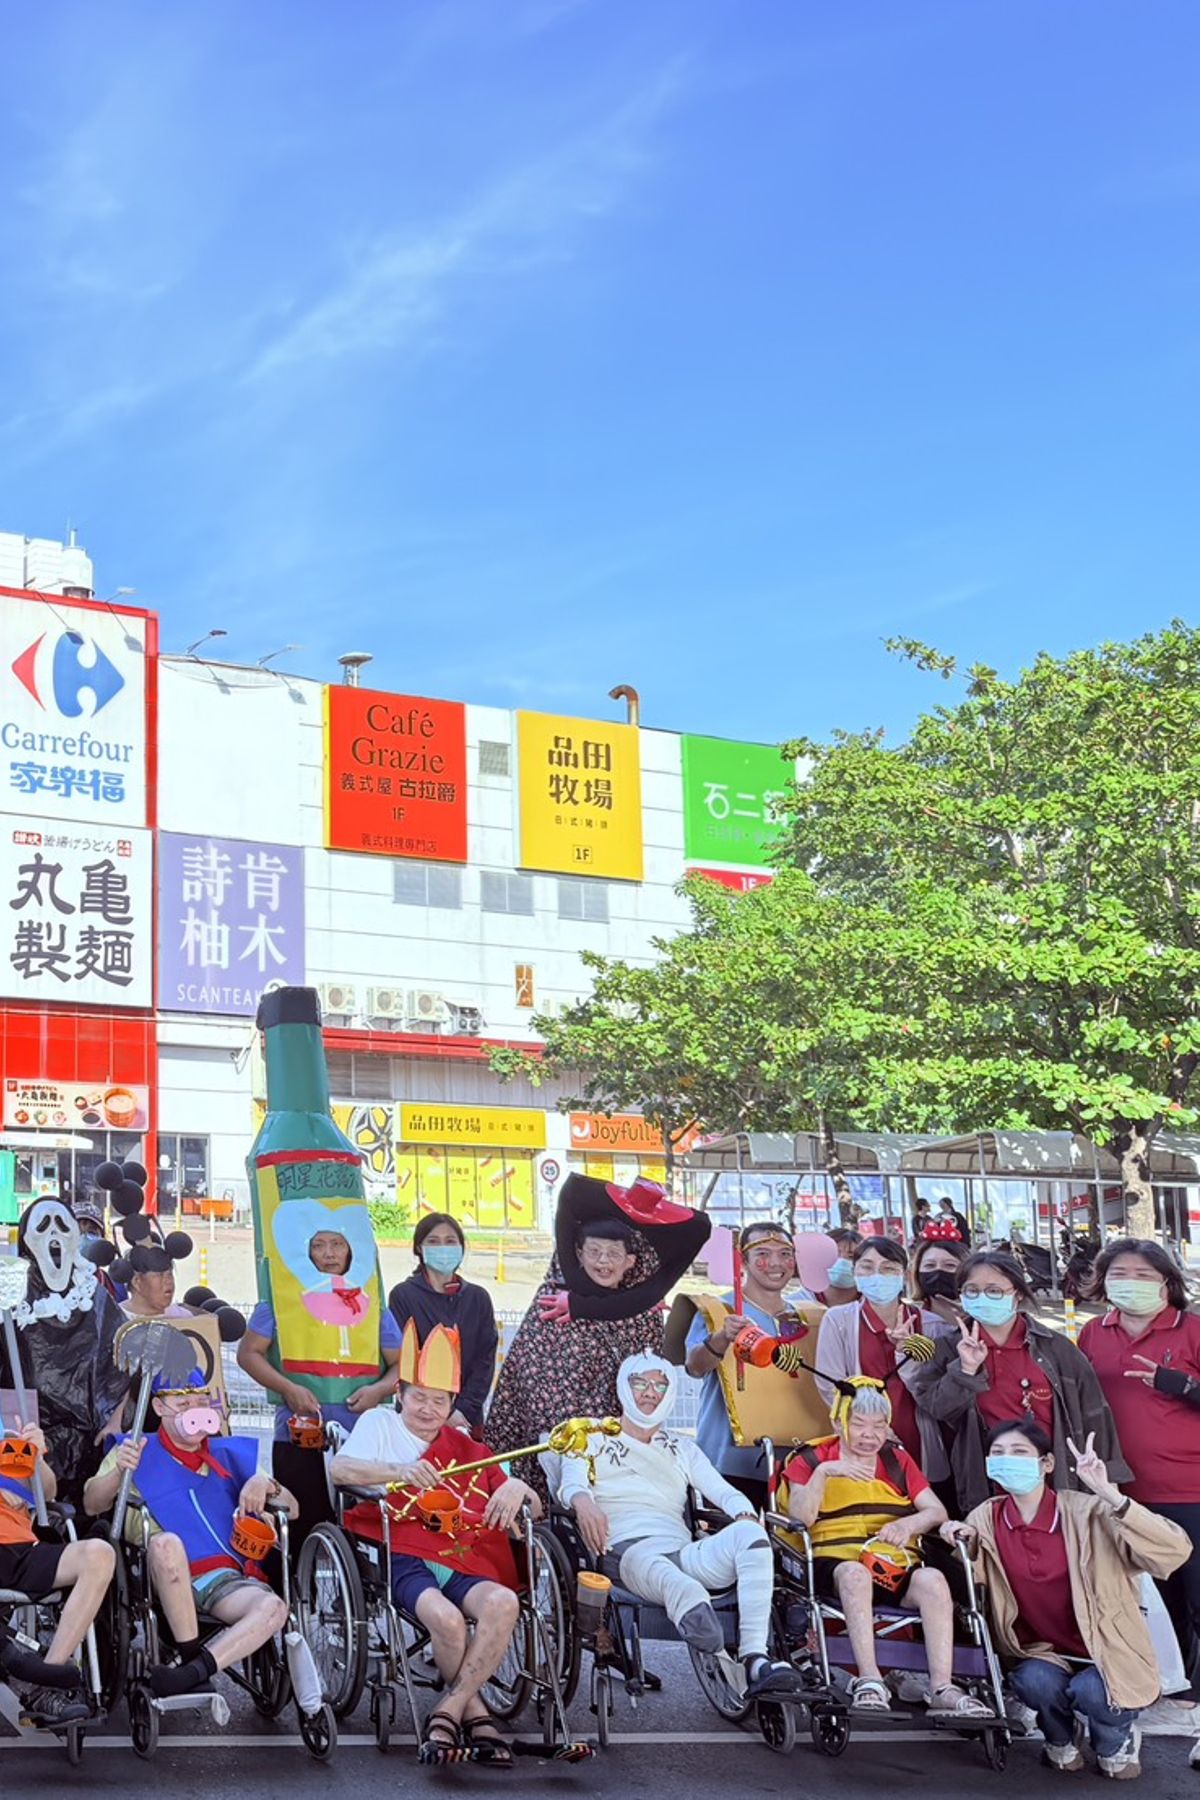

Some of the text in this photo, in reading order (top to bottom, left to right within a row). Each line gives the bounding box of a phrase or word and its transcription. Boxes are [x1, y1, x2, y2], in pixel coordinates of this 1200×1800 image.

[367, 704, 435, 738] Café
[1, 722, 133, 763] Carrefour
[352, 737, 445, 774] Grazie
[548, 735, 611, 772] 品田
[10, 761, 125, 803] 家樂福
[399, 778, 456, 803] 古拉爵
[548, 774, 612, 811] 牧場
[576, 847, 590, 860] 1F
[182, 846, 288, 912] 詩肯
[179, 906, 287, 972] 柚木
[409, 1114, 481, 1133] 品田牧場
[592, 1119, 650, 1144] Joyfull
